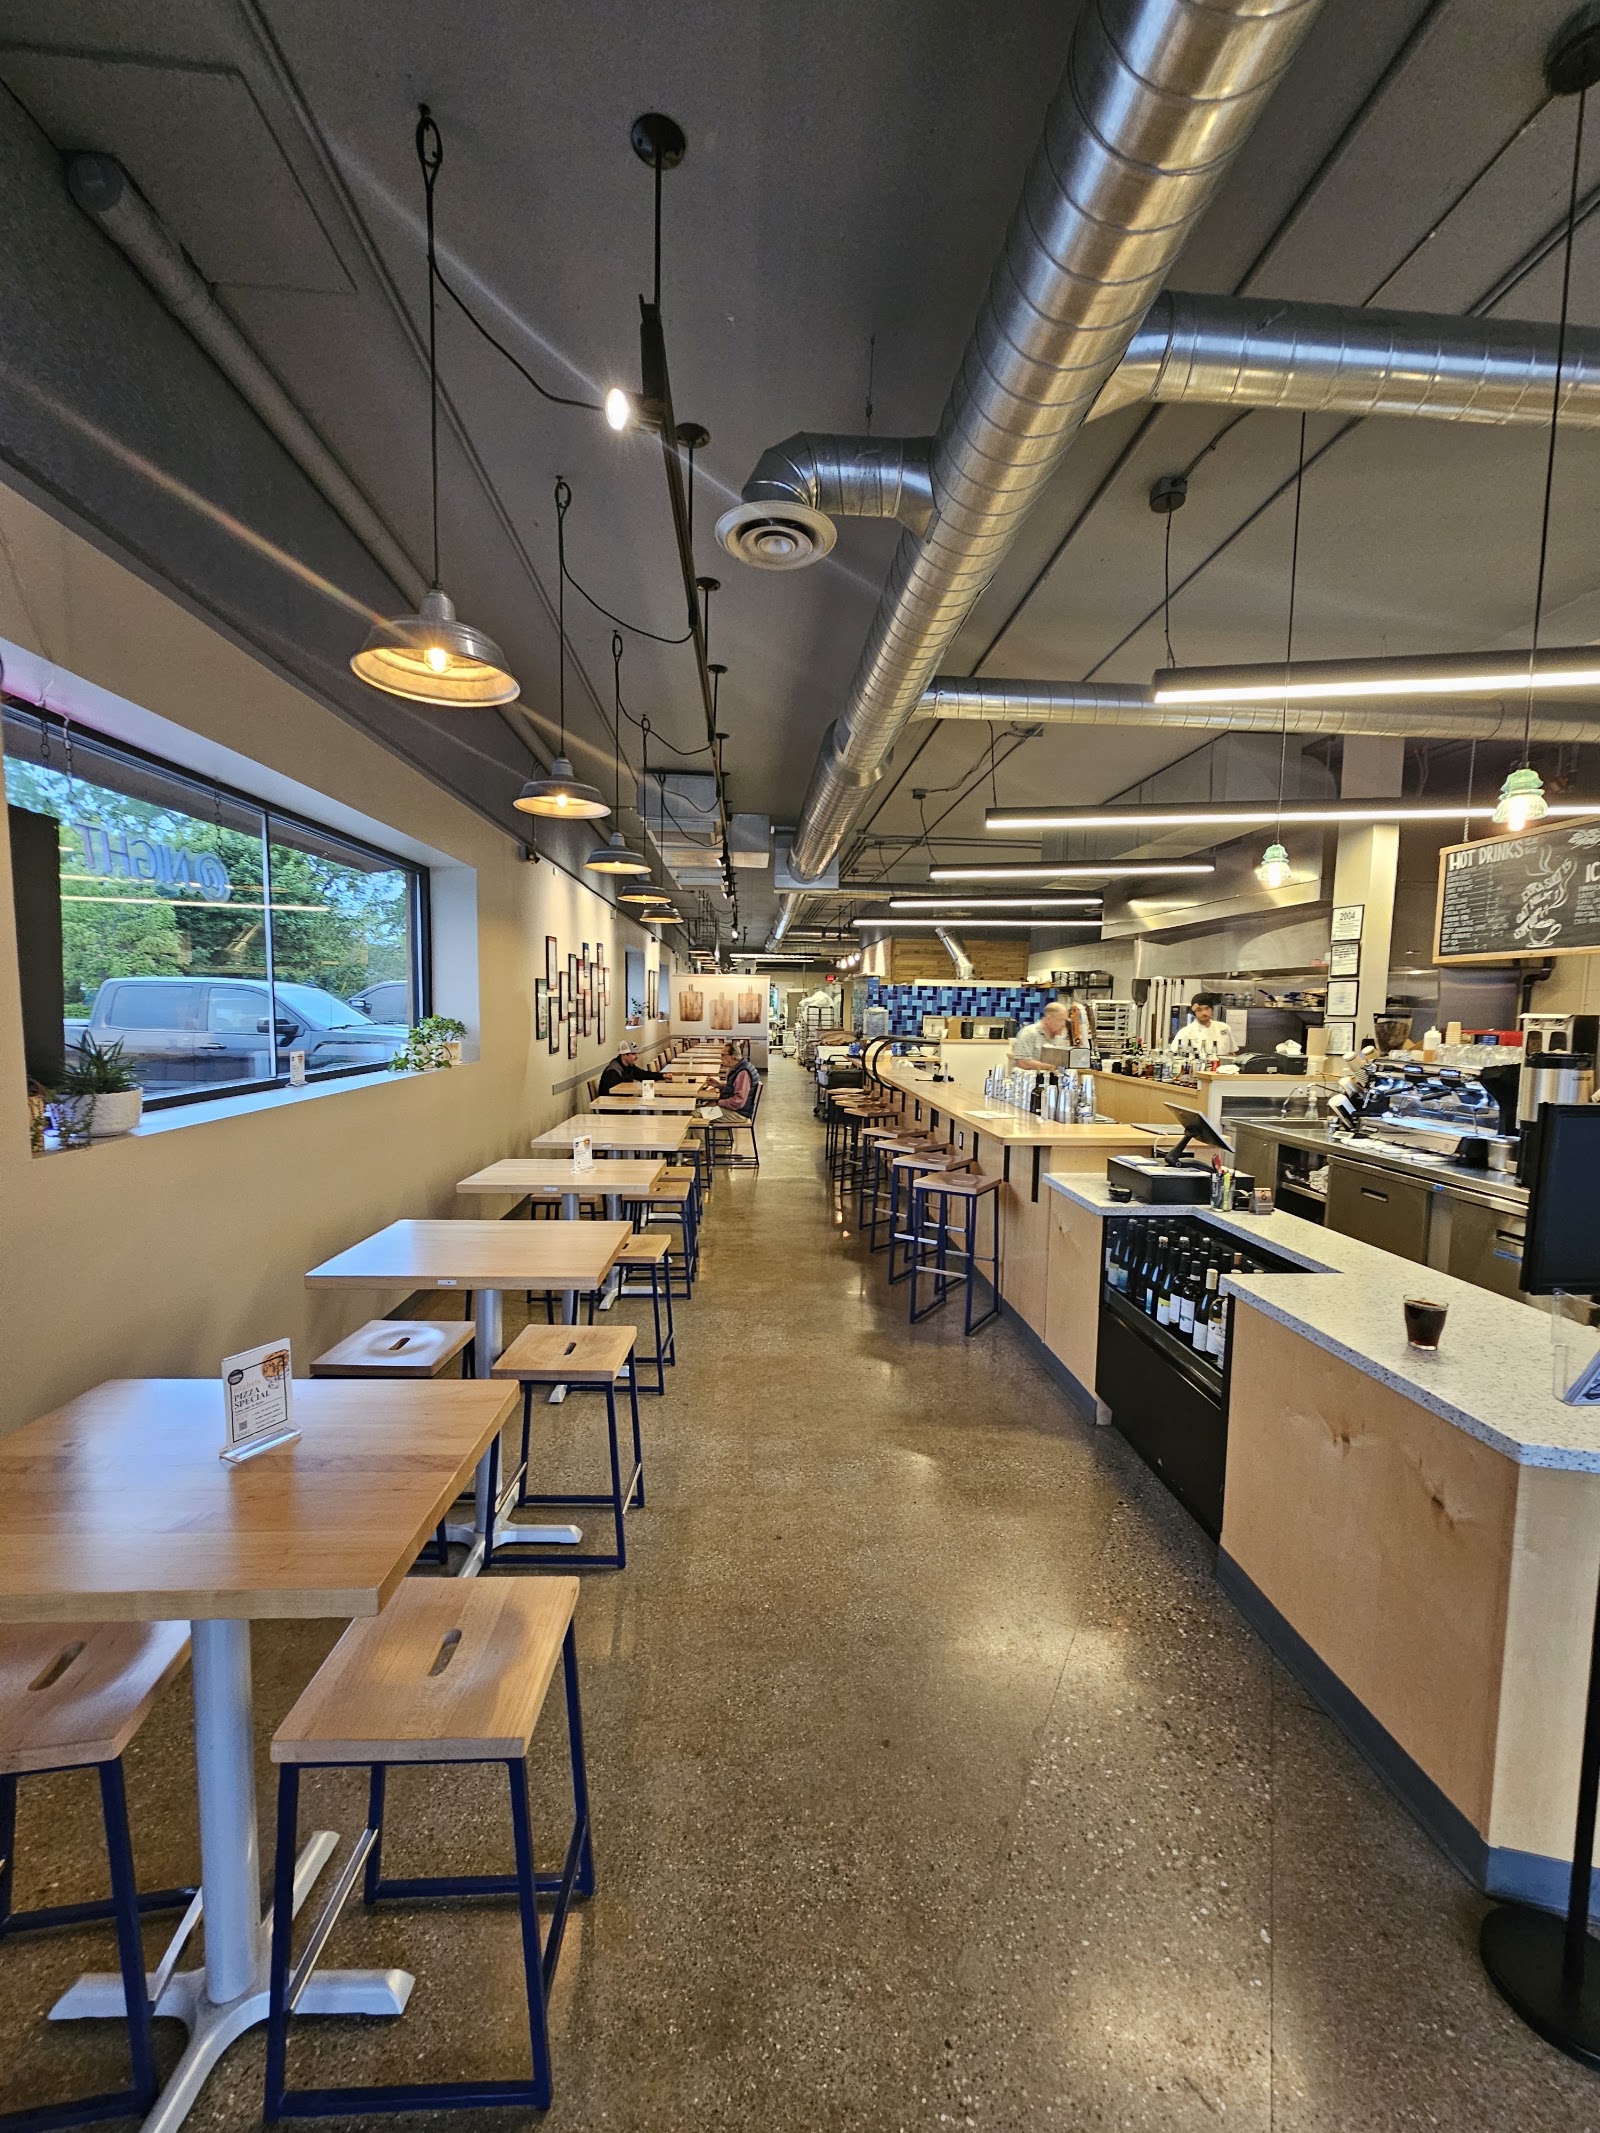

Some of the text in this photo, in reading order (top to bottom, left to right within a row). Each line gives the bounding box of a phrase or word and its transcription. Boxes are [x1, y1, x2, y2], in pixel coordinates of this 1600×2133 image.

[1449, 849, 1476, 871] HOT
[1478, 840, 1524, 865] DRINKS
[1339, 911, 1356, 921] 2004
[234, 1387, 260, 1401] PIZZA
[234, 1390, 271, 1410] SPECIAL
